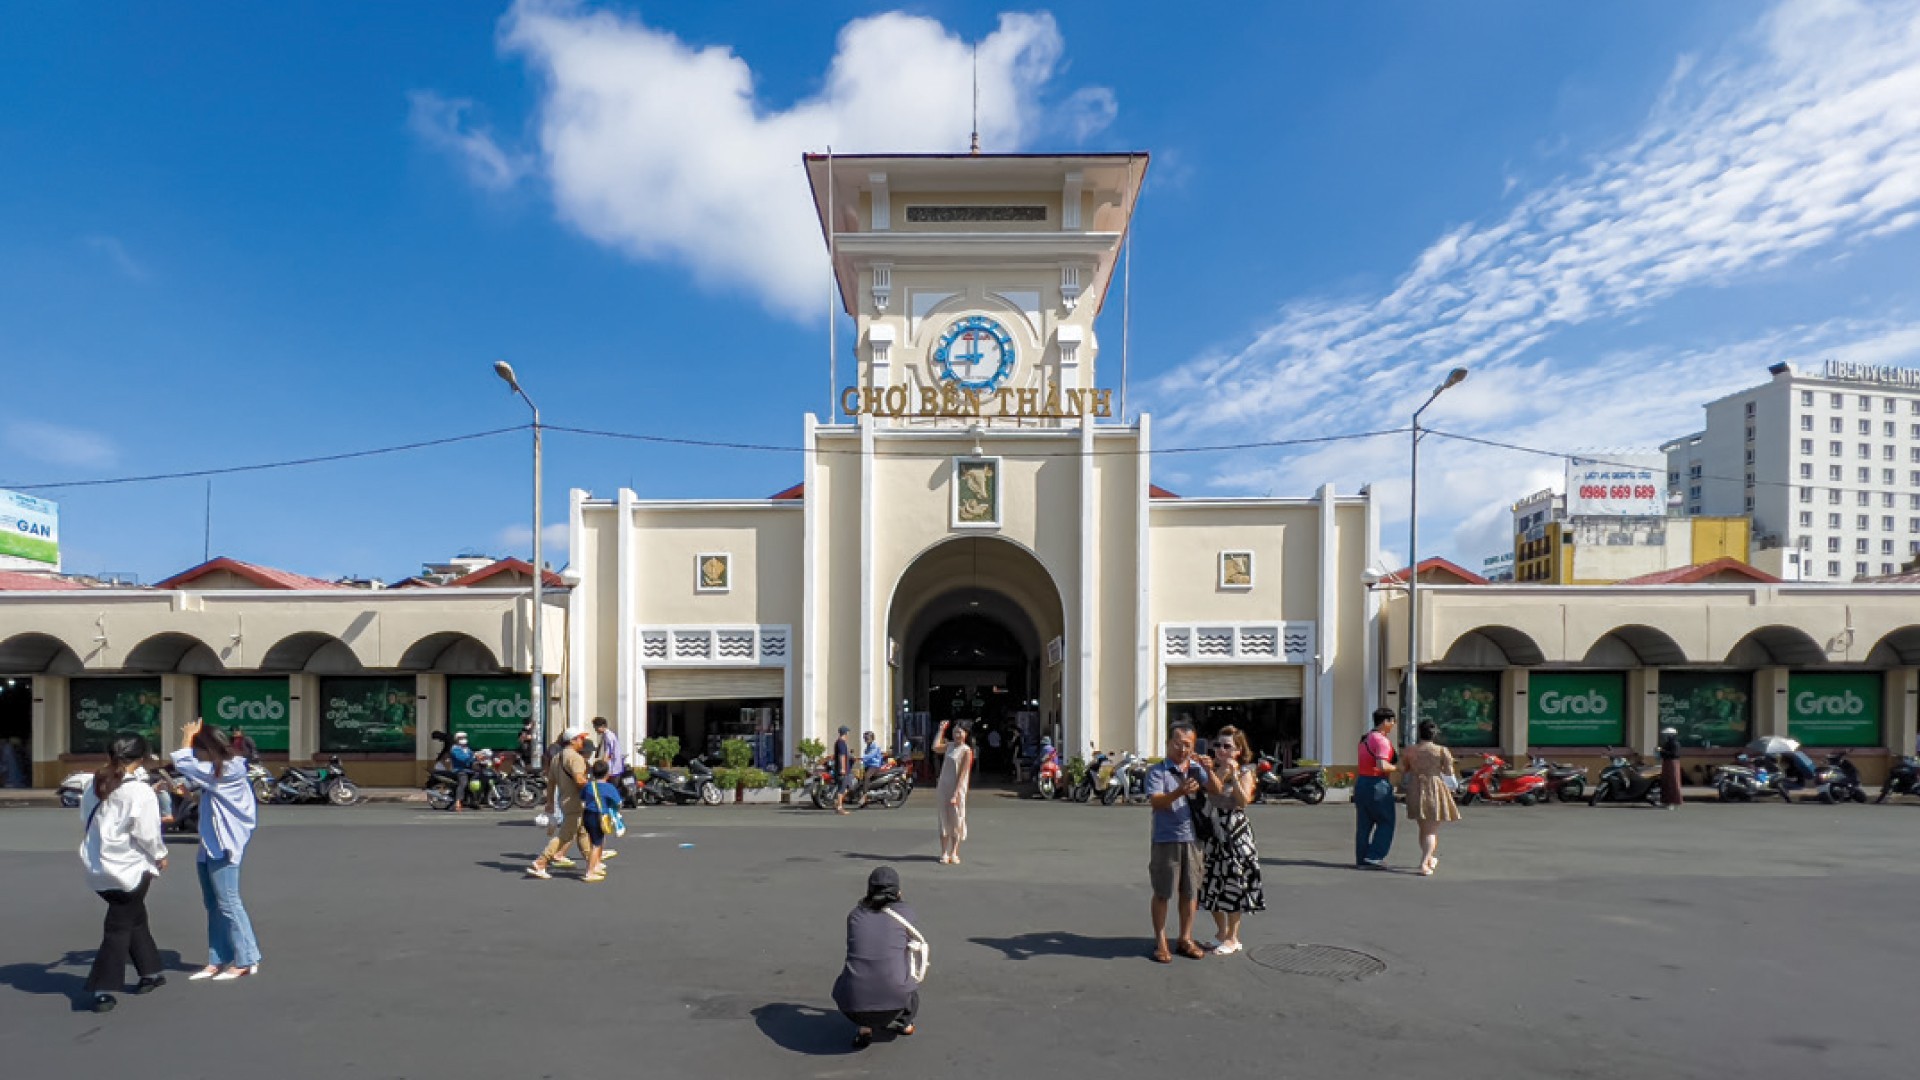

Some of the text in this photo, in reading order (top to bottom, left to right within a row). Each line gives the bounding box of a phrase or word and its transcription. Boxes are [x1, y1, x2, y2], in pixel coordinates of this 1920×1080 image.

[842, 383, 907, 419] CHỢ
[993, 380, 1112, 417] THÀNH
[17, 519, 51, 537] GAN
[217, 695, 284, 720] Grab
[465, 693, 532, 718] Grab
[1540, 689, 1608, 714] Grab
[1795, 689, 1864, 714] Grab
